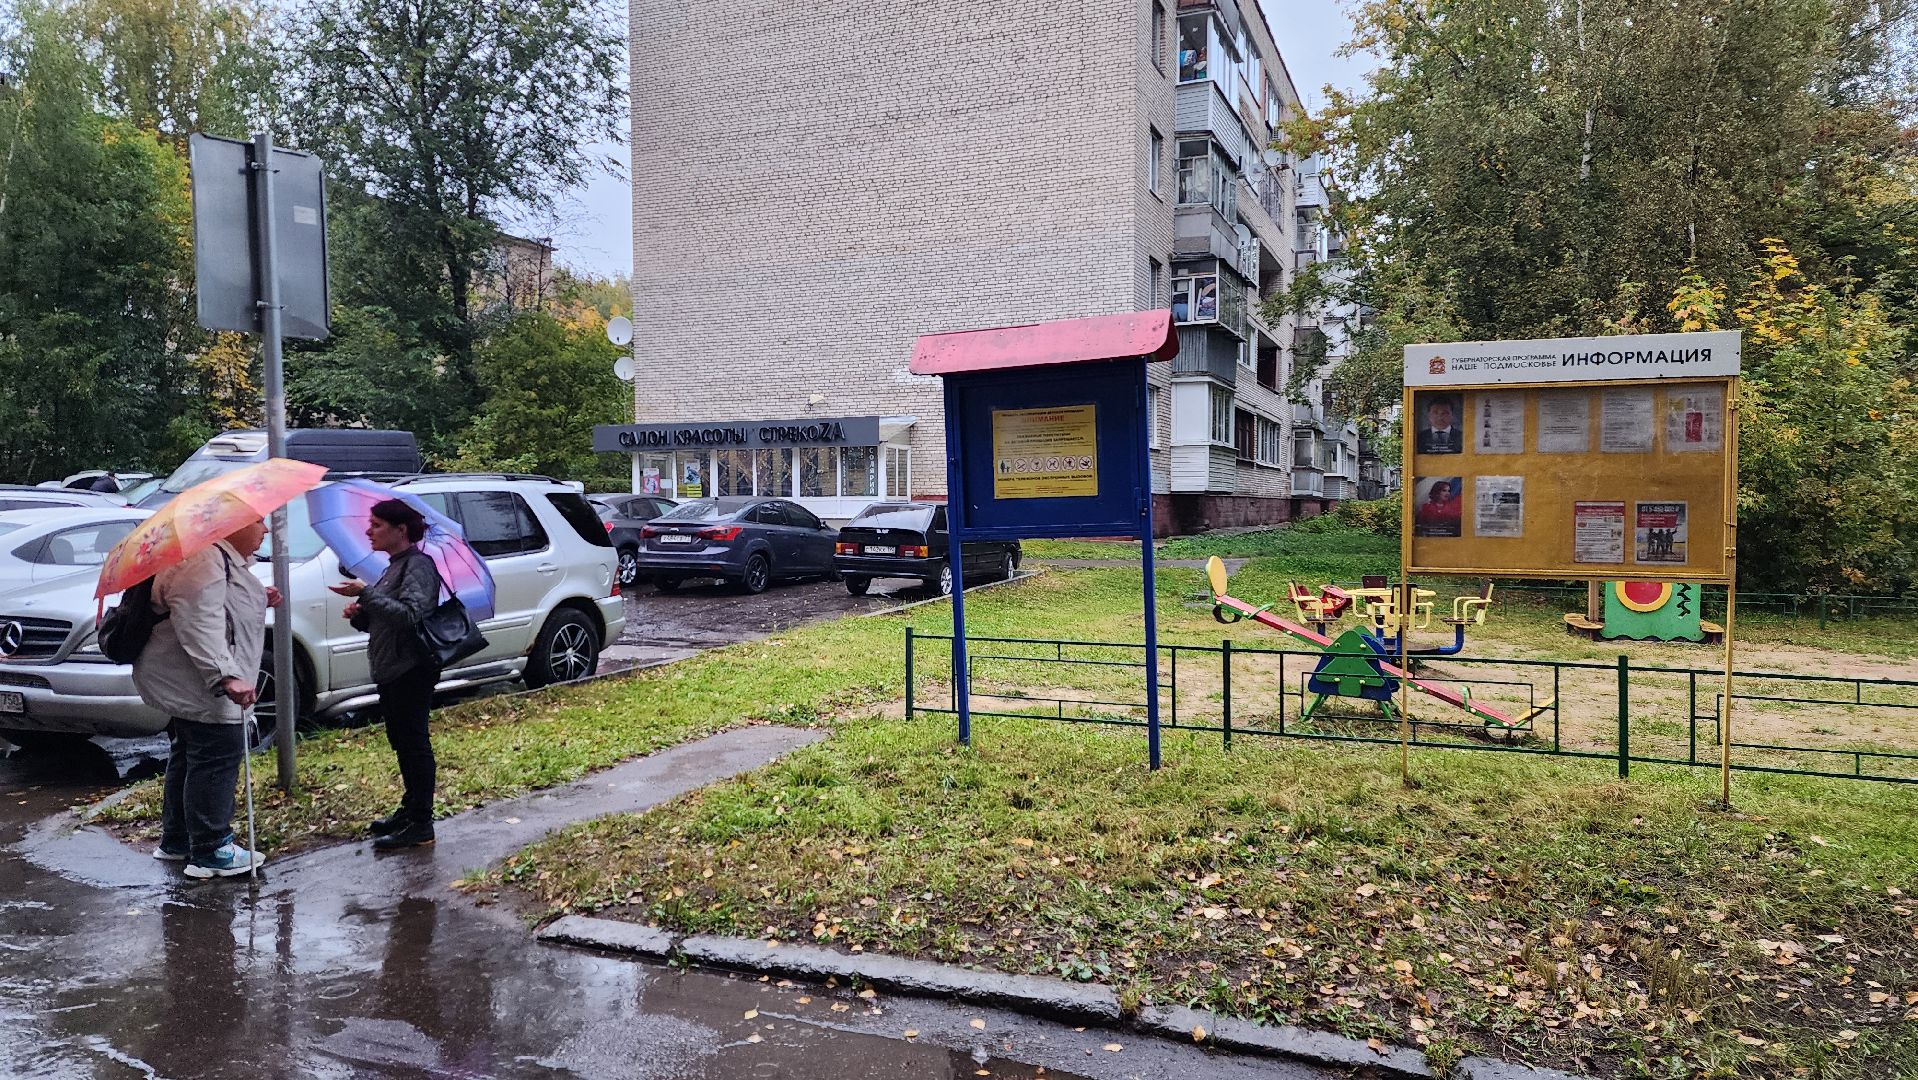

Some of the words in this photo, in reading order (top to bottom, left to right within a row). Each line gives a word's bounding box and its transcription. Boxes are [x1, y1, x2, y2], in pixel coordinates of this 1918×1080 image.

[1451, 355, 1511, 364] ГУБЕРНАТОРСКАЯ
[1512, 353, 1557, 362] ПРОГРАММА
[1562, 348, 1712, 367] ИНФОРМАЦИЯ
[1451, 363, 1478, 371] НАШЕ
[1483, 360, 1557, 370] ПОДМОСКОВЬЕ
[618, 430, 670, 447] САЛОН
[673, 426, 748, 446] КРАСОТЫ
